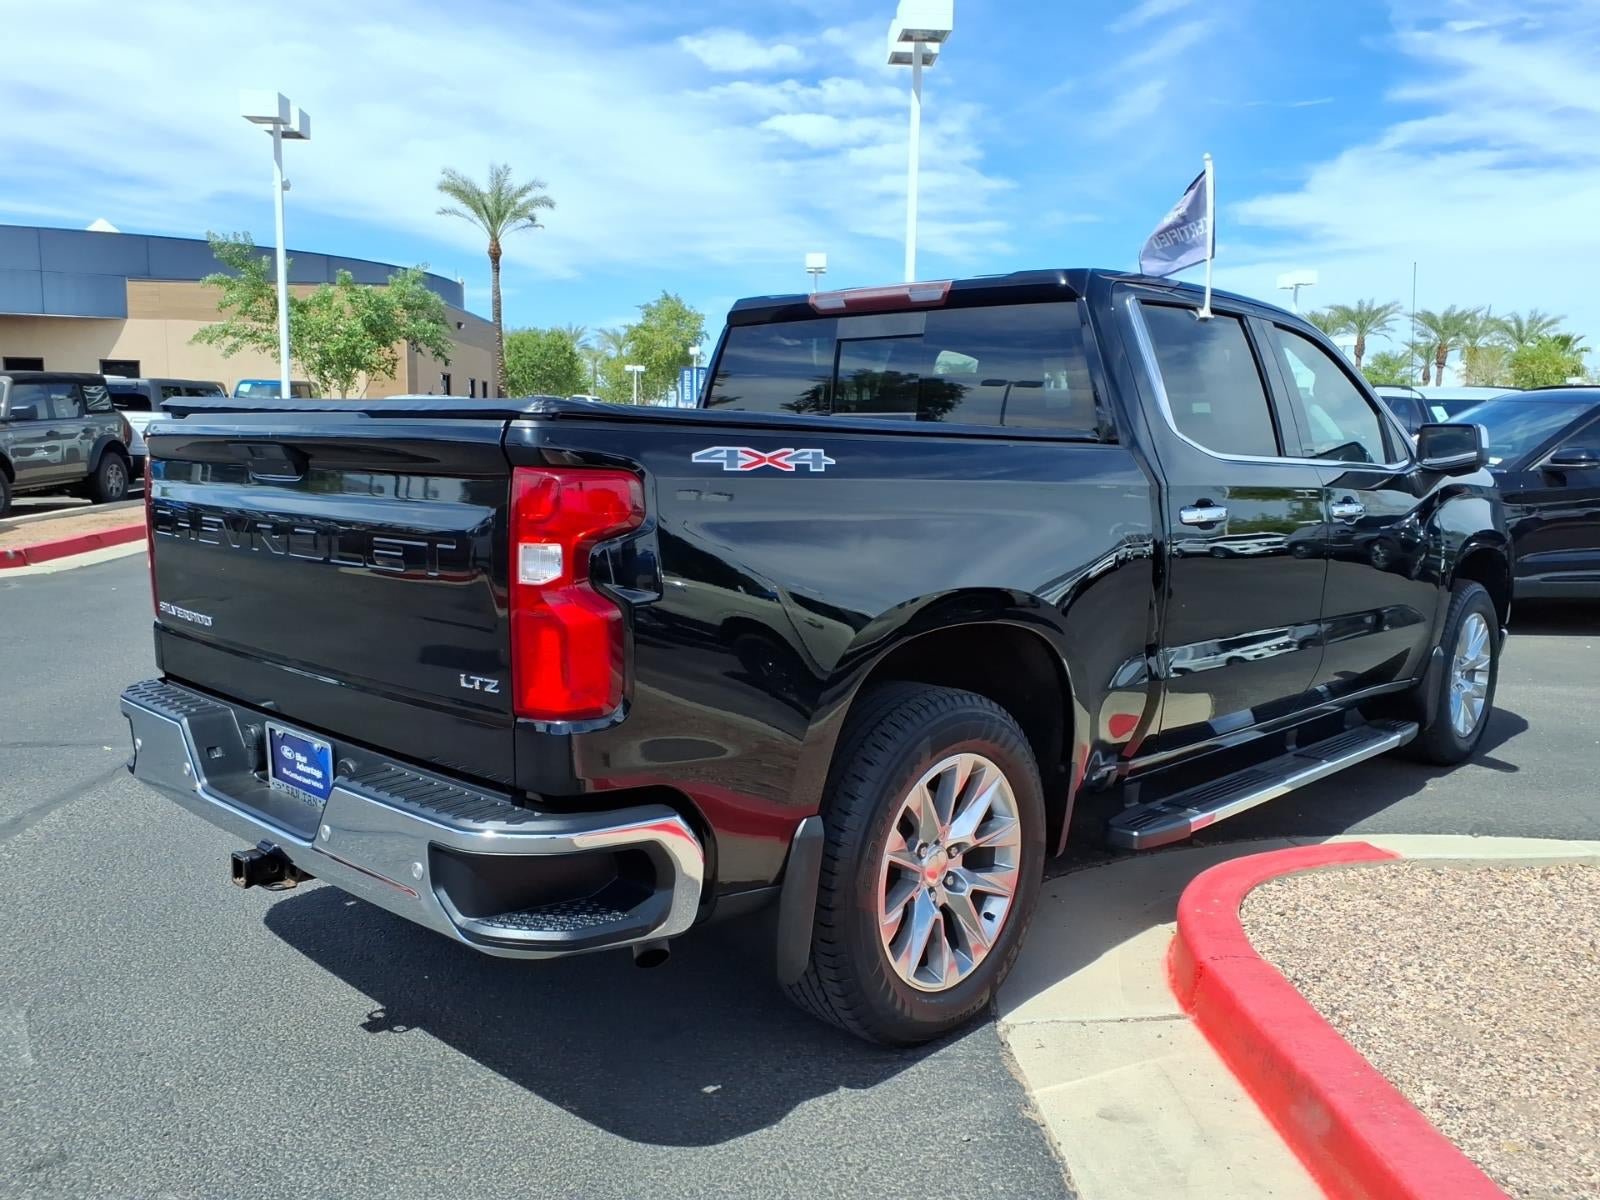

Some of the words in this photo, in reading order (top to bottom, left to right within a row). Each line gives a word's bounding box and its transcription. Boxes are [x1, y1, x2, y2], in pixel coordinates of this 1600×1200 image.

[154, 505, 457, 577] CHEVROLET
[159, 601, 213, 627] SILVERADO
[460, 673, 500, 694] LTZ
